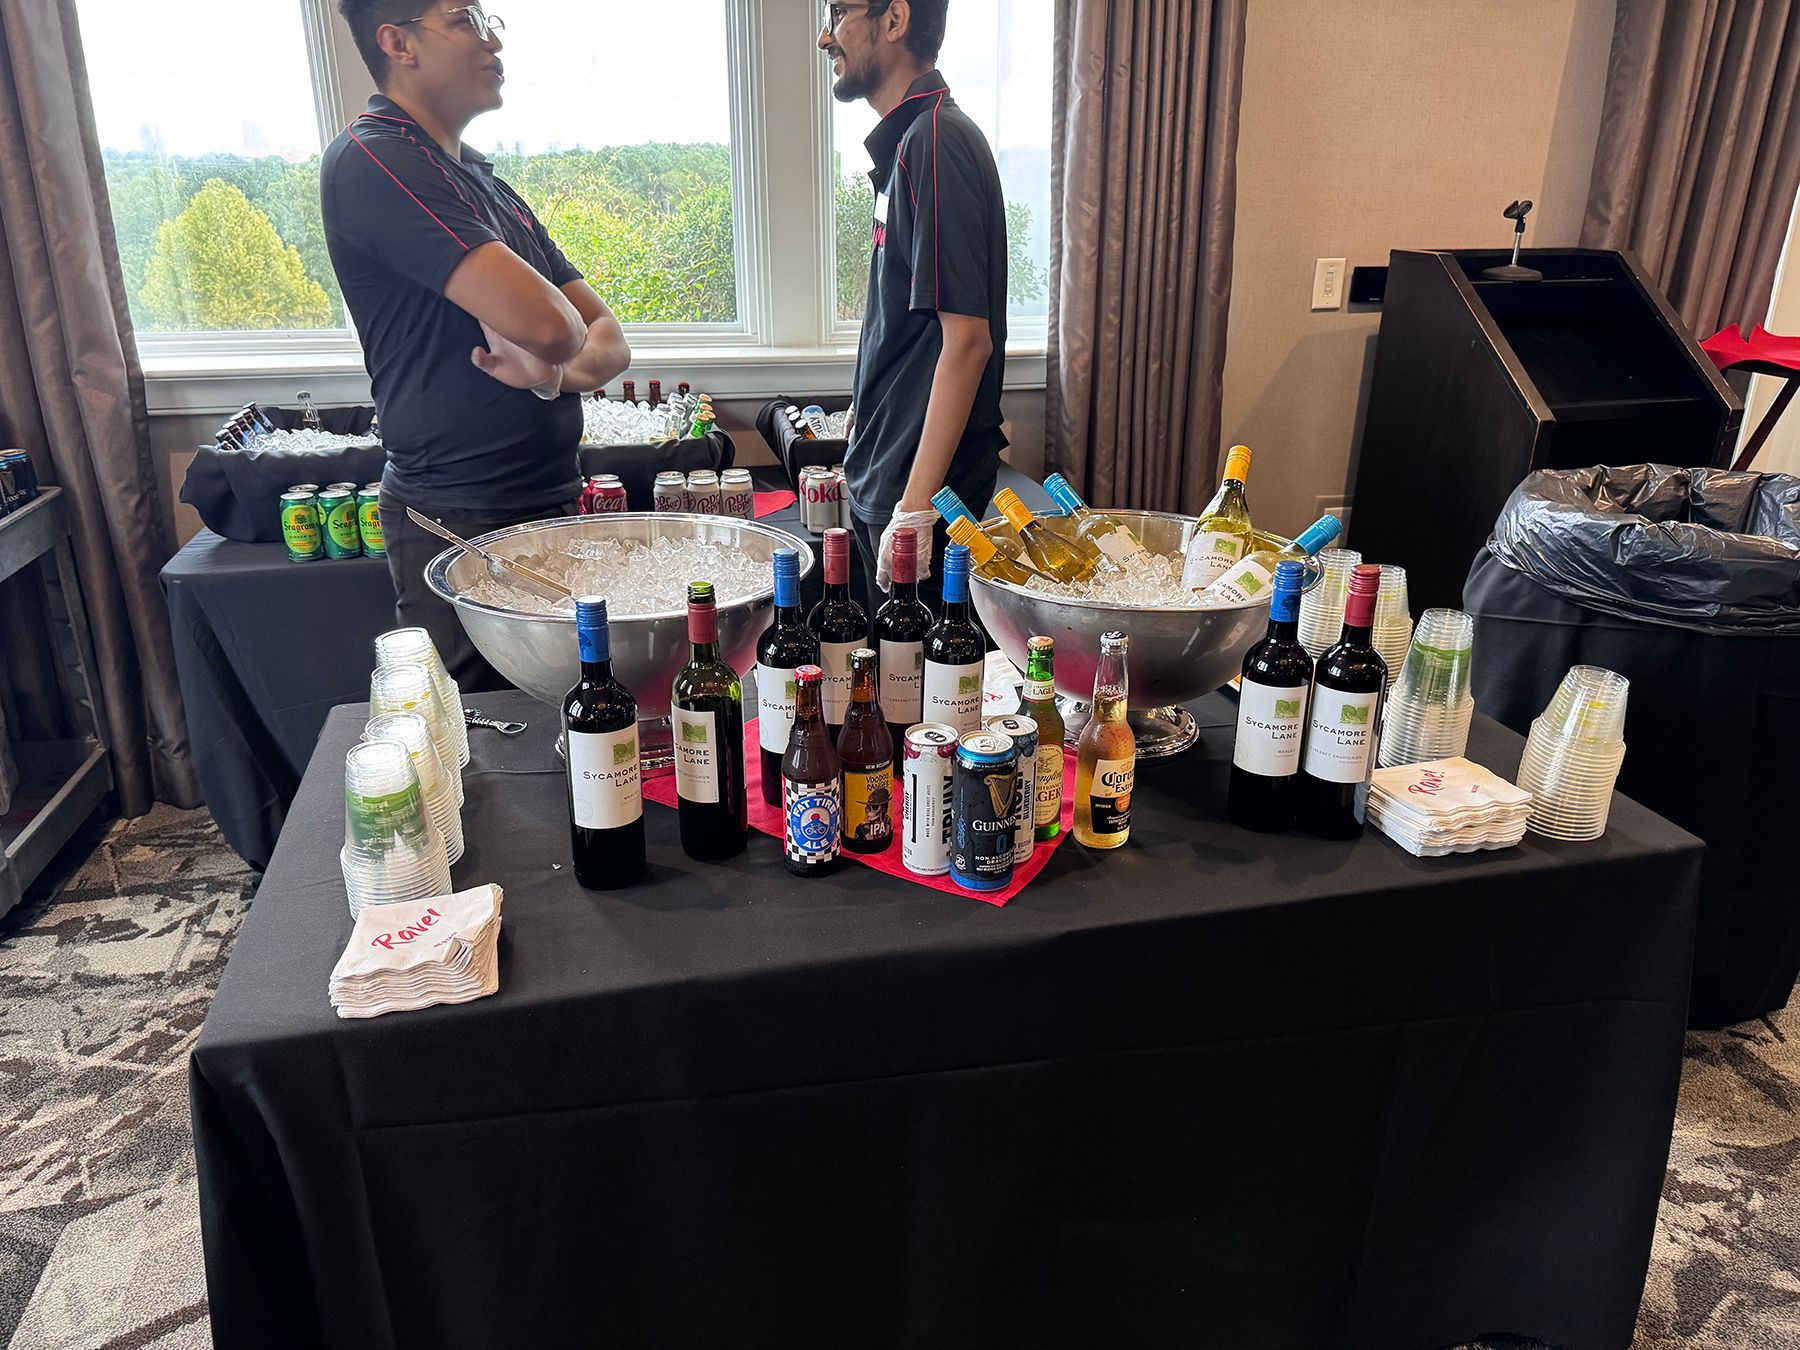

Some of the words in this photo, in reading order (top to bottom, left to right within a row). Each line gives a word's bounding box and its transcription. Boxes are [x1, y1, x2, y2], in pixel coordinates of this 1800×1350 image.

[807, 482, 840, 504] oke
[725, 497, 752, 513] Pepp
[360, 517, 382, 530] Seagr
[821, 675, 852, 683] SYCAM
[889, 673, 922, 682] SYCAM
[762, 698, 796, 712] SYCAM
[932, 695, 980, 707] SYCAMORE
[957, 704, 979, 715] LANE
[1245, 716, 1299, 732] SYCAMORE
[1312, 719, 1367, 738] SYCAMORE
[1271, 731, 1298, 741] LANE
[1336, 736, 1366, 746] LANE
[675, 742, 710, 757] CAMORE
[683, 753, 710, 766] LANE
[582, 763, 638, 781] SYCAMORE
[1101, 769, 1134, 789] Coro
[615, 772, 639, 788] LANE
[1023, 780, 1032, 820] BLUEBERRY
[1036, 787, 1062, 802] AGER
[792, 800, 811, 818] FAT
[814, 797, 837, 815] TIRE
[870, 822, 886, 836] IPA
[803, 838, 830, 849] ALE
[371, 908, 442, 950] Ravel
